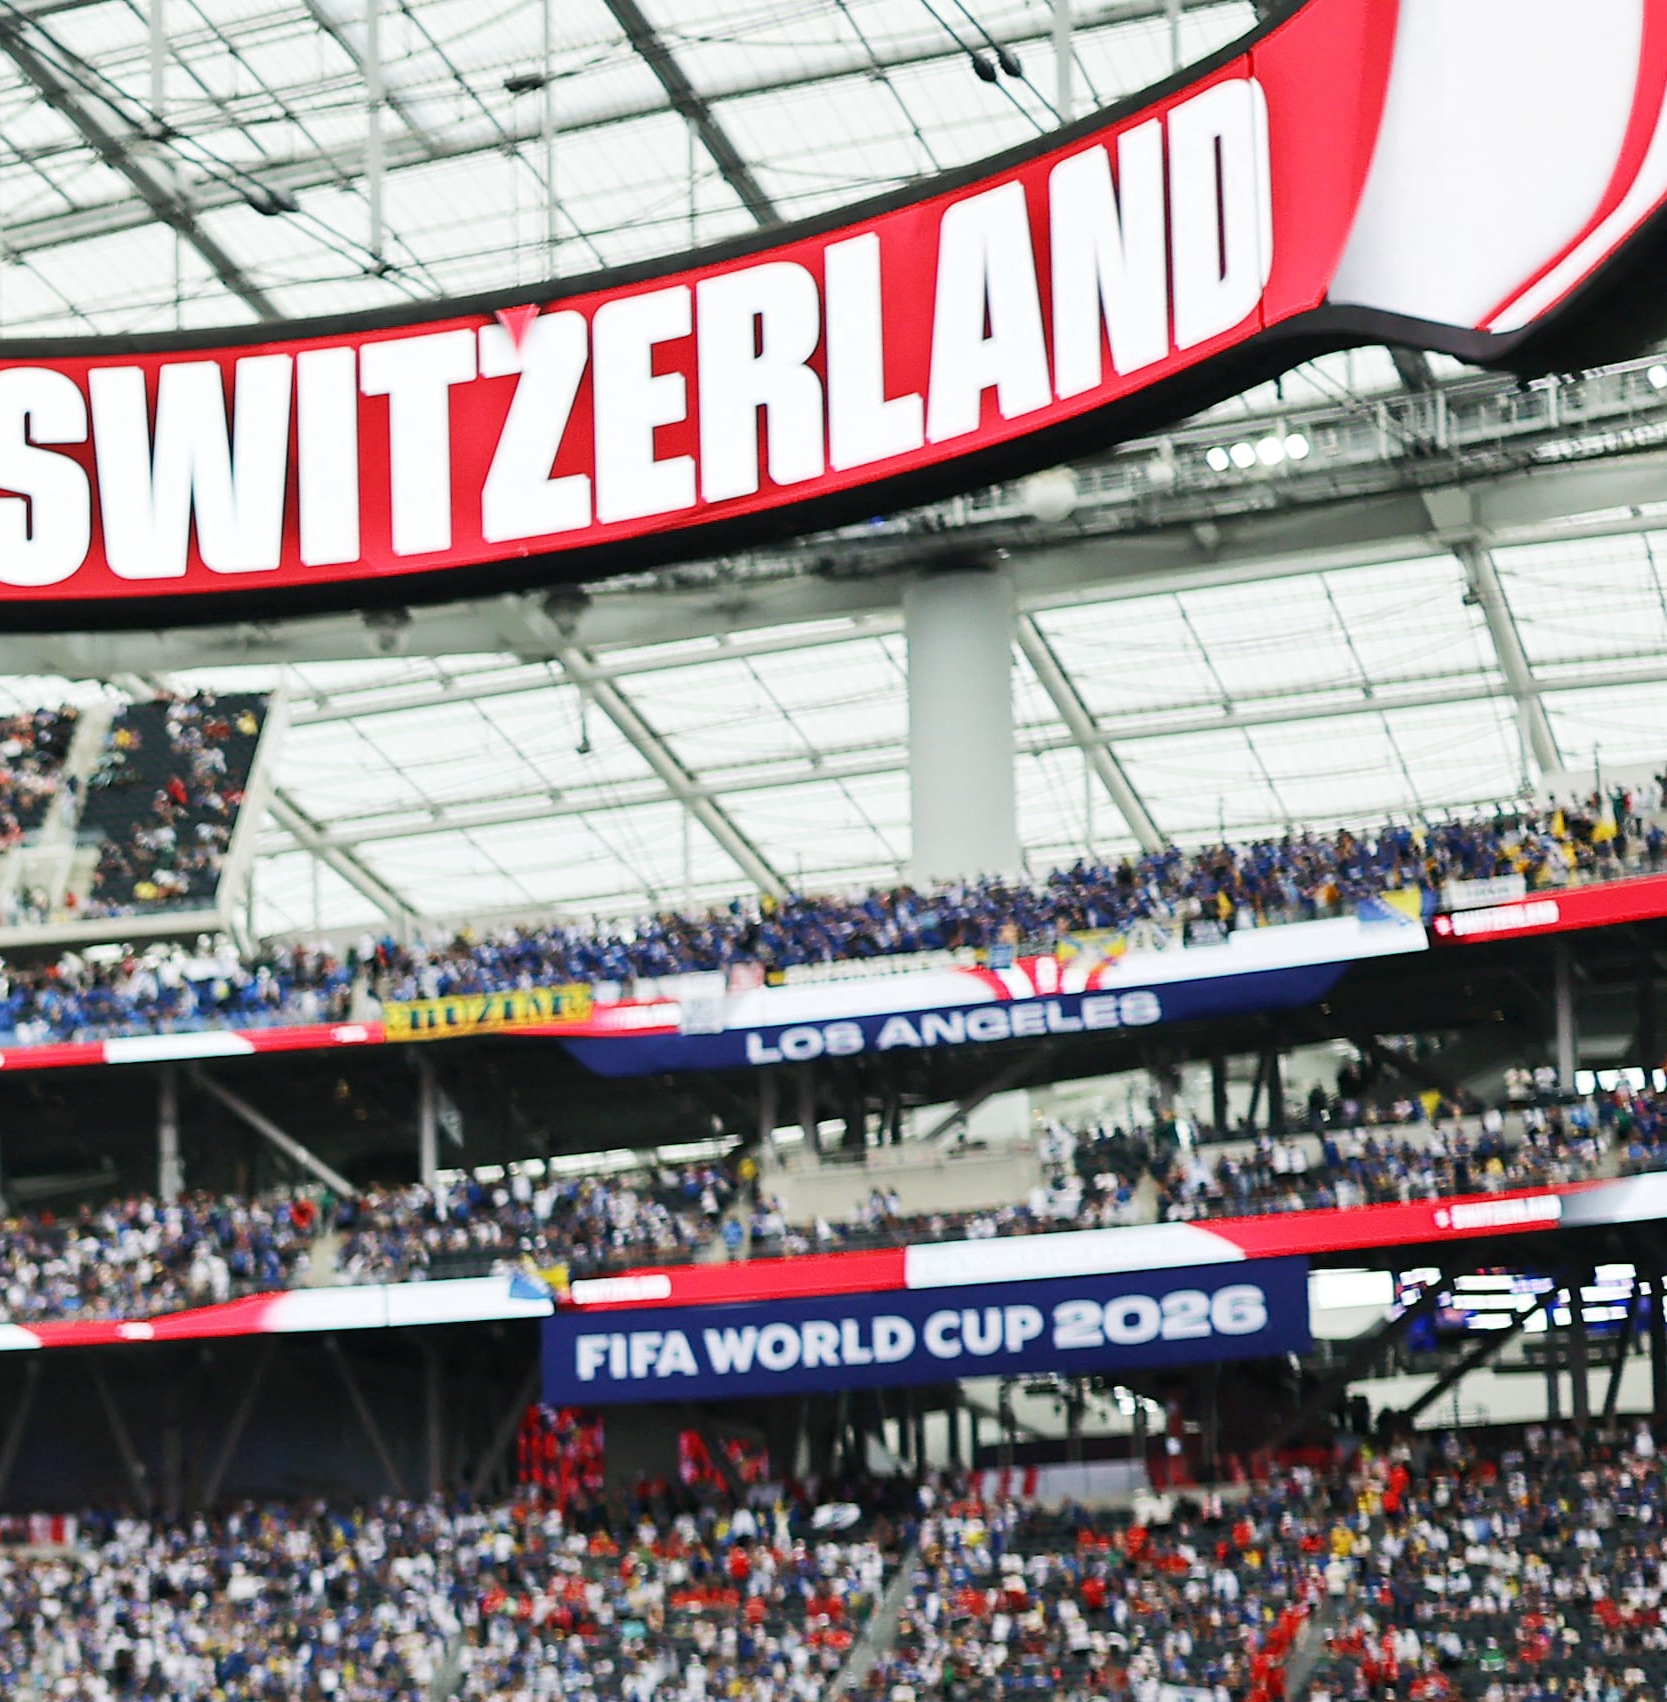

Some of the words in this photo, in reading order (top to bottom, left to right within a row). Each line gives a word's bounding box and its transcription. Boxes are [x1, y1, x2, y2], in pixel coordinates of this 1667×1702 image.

[745, 1020, 865, 1065] LOS
[874, 991, 1162, 1051] ANGELES
[576, 1330, 699, 1382] FIFA
[702, 1315, 917, 1375] WORLD
[923, 1305, 1045, 1359] CUP
[1052, 1284, 1268, 1349] 2026
